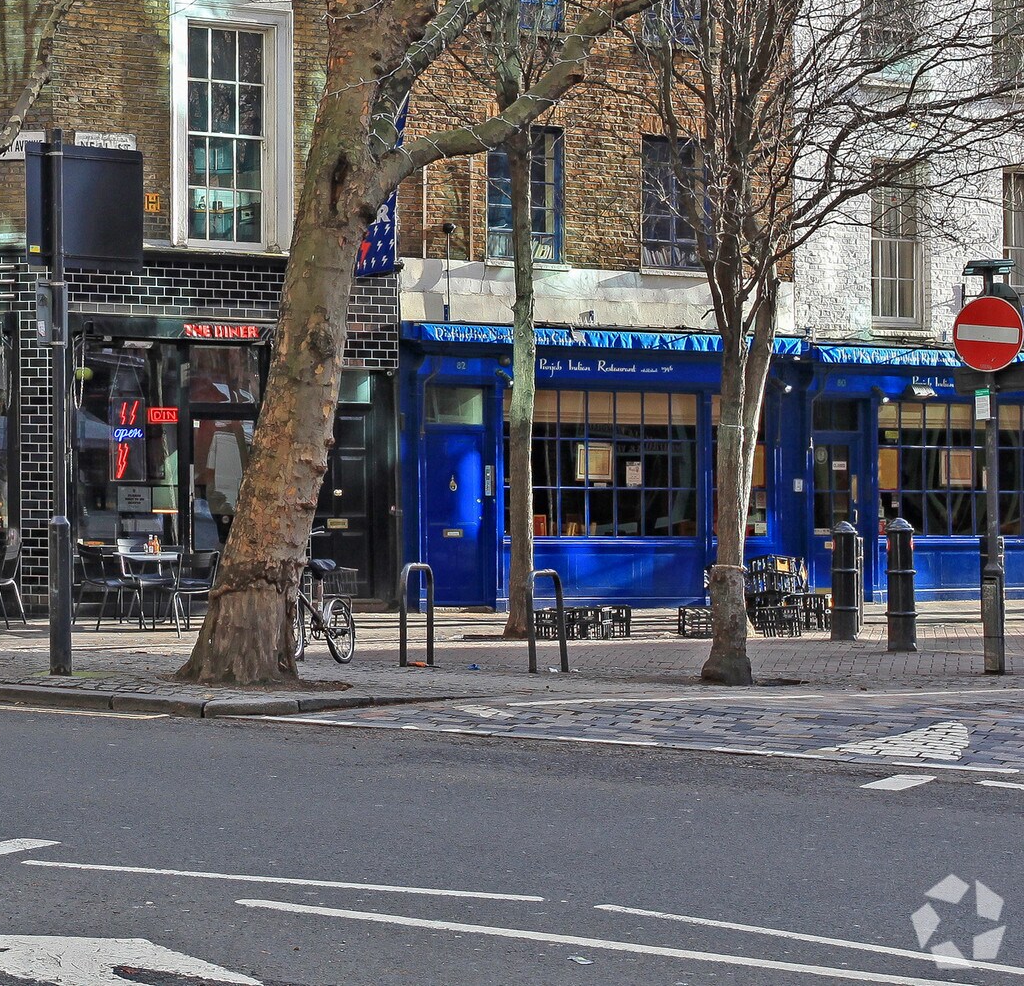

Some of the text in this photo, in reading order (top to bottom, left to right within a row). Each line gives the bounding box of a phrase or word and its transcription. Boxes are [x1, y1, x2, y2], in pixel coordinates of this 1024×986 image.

[183, 324, 259, 338] THE DINER
[456, 361, 466, 370] 82
[568, 359, 590, 371] Indian
[597, 360, 636, 372] Restaurant
[114, 428, 143, 442] open
